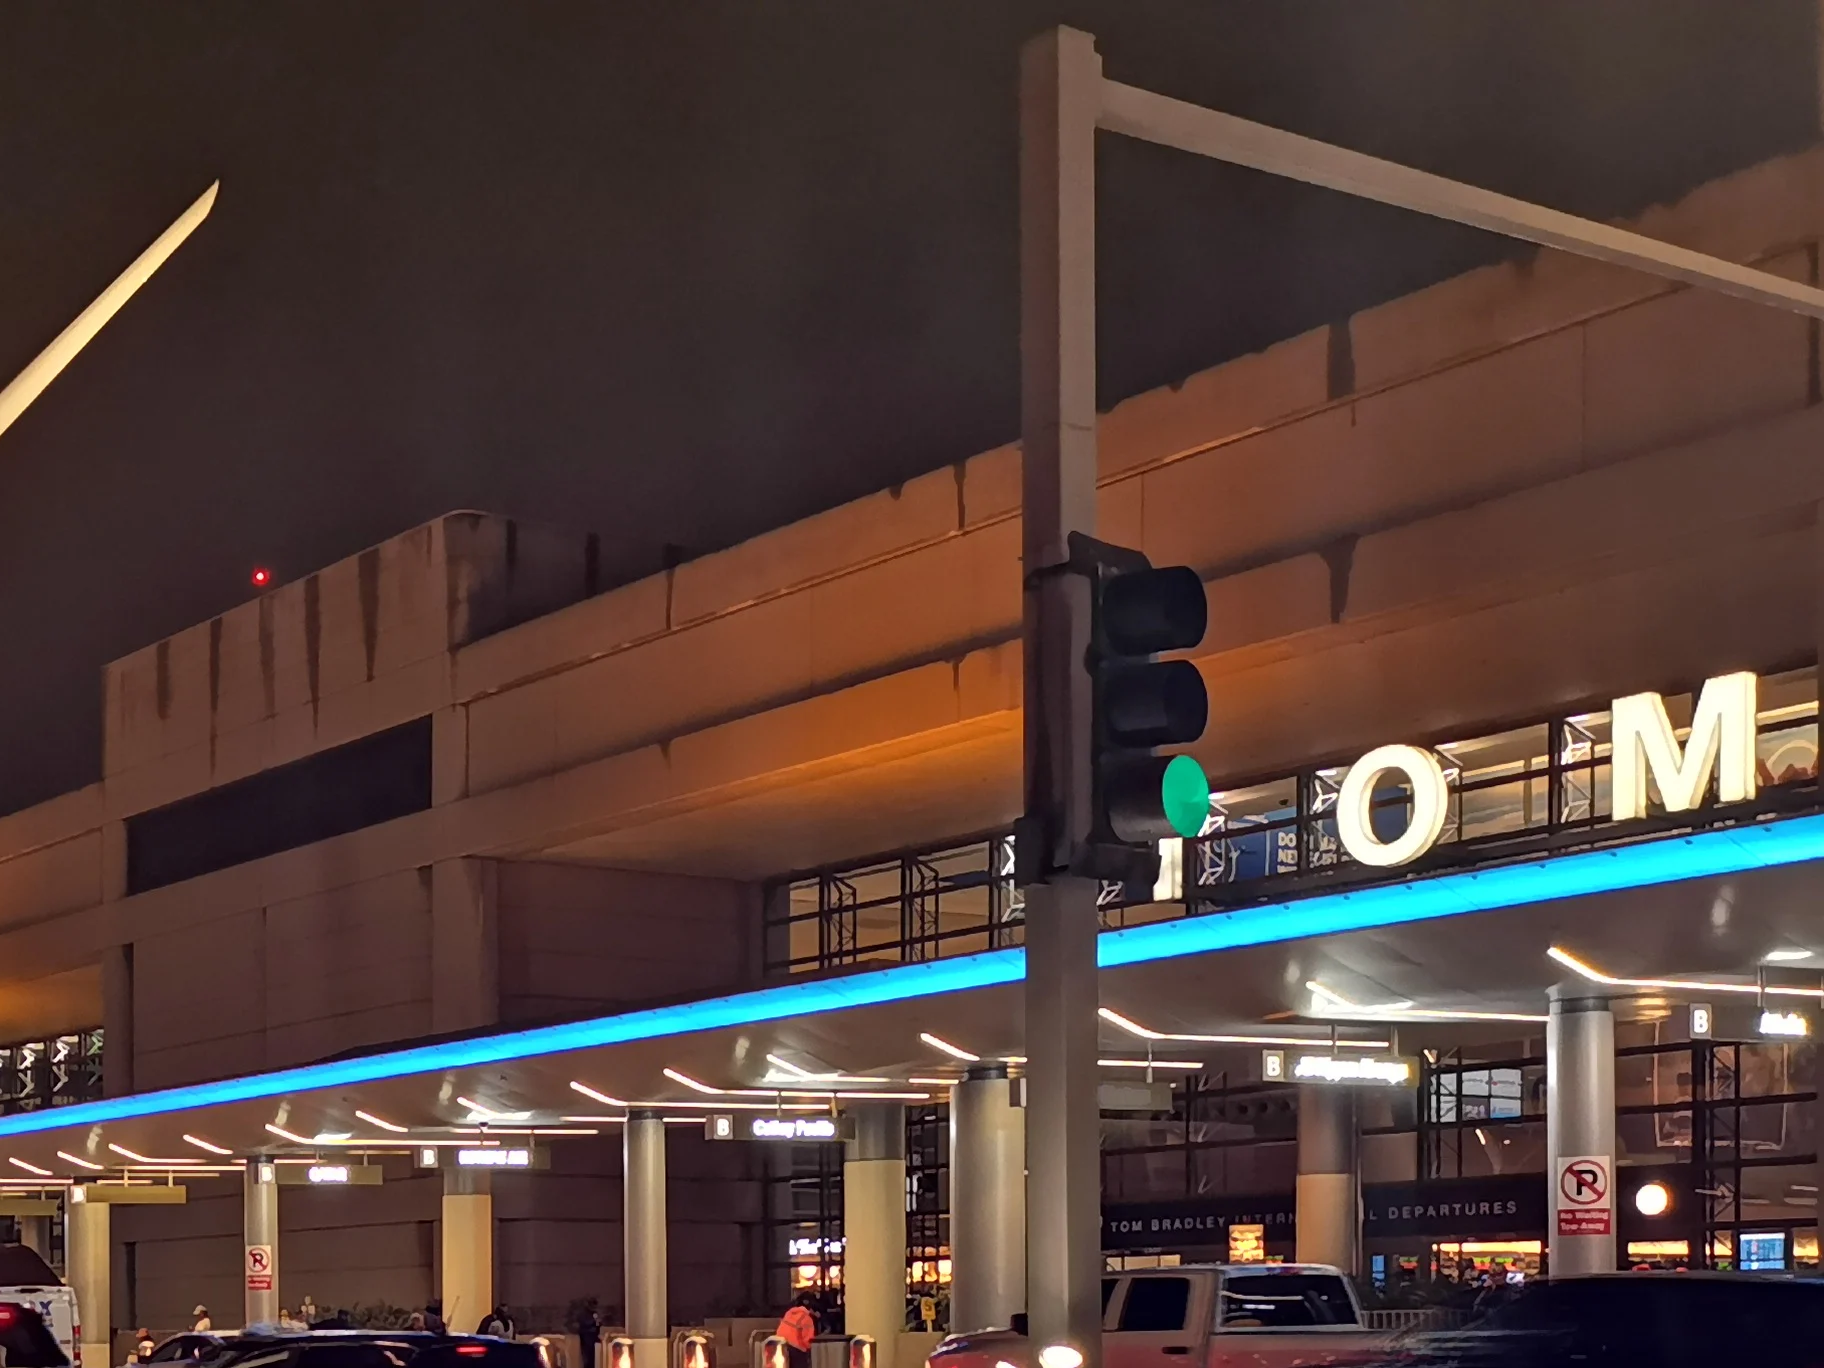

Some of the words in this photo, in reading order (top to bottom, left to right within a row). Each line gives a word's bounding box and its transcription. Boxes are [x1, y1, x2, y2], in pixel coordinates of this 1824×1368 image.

[716, 1118, 730, 1137] B
[1110, 1219, 1143, 1233] TOM
[1151, 1215, 1226, 1232] BRADLEY
[1388, 1200, 1517, 1220] DEPARTURES
